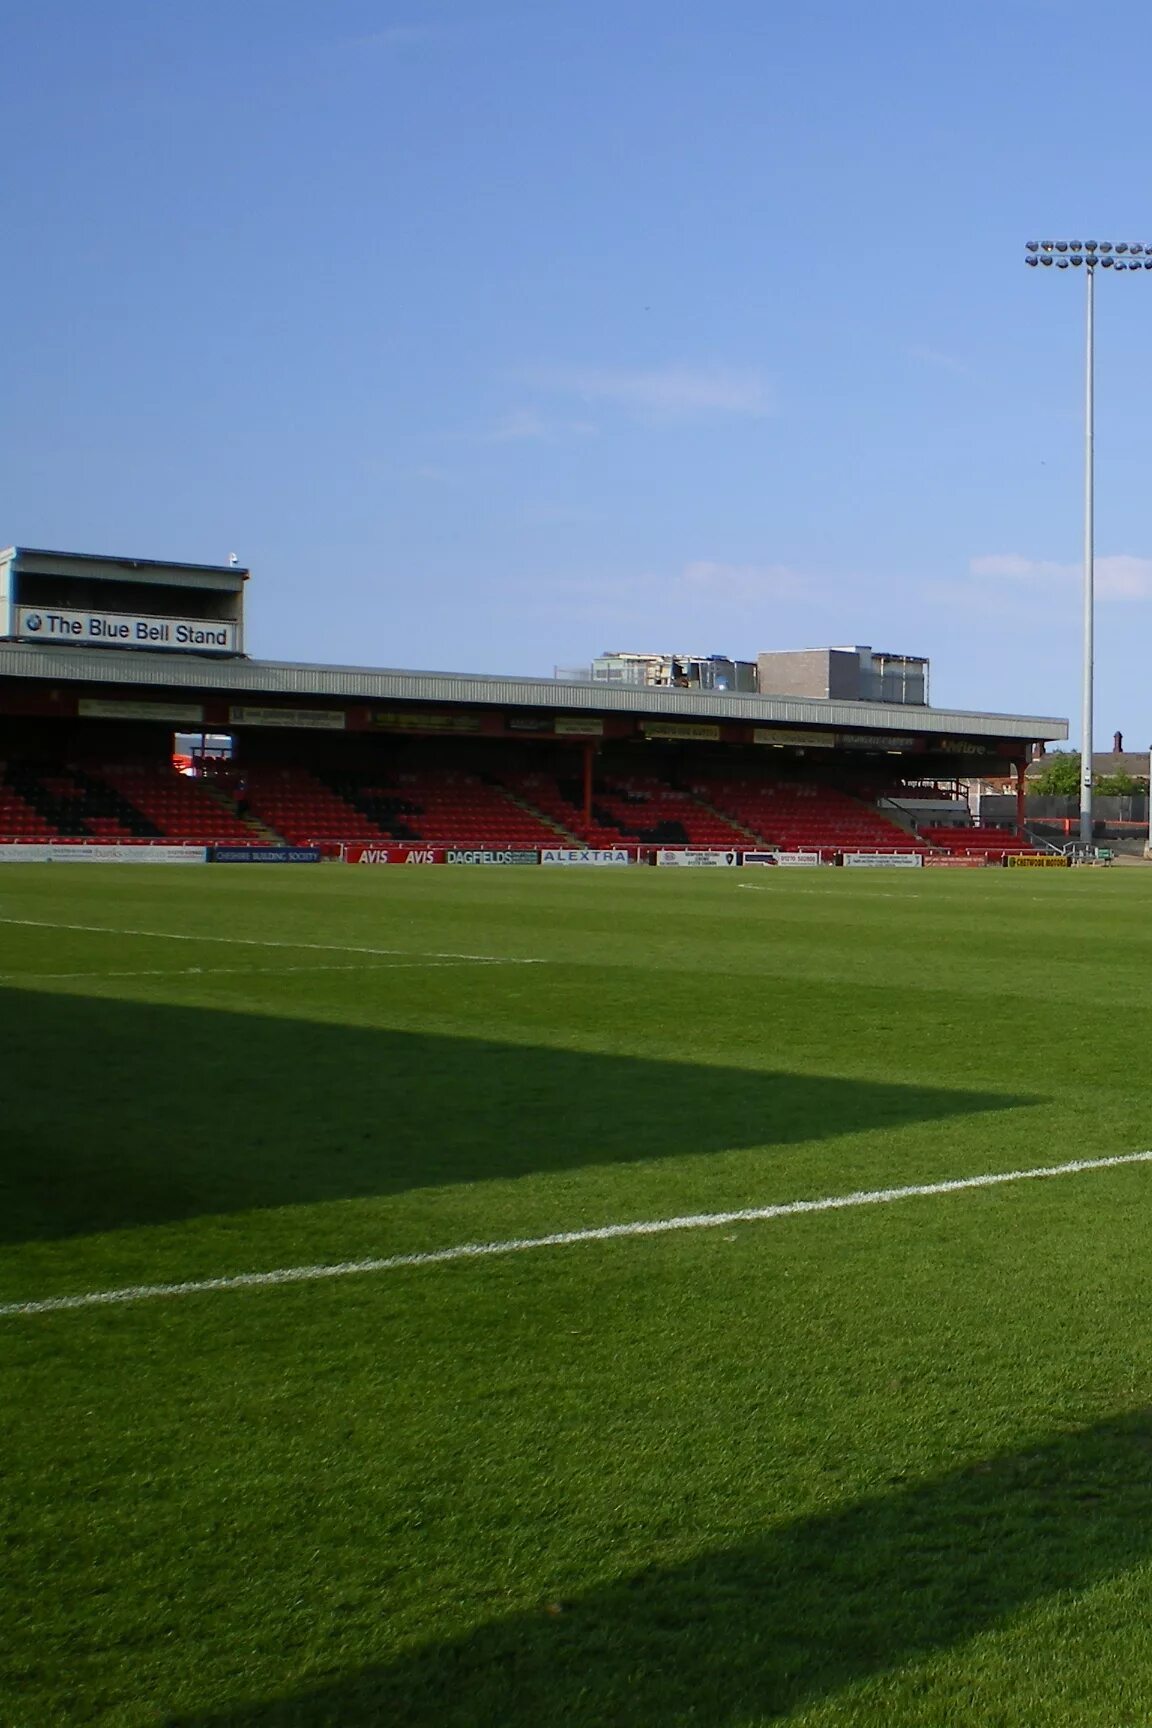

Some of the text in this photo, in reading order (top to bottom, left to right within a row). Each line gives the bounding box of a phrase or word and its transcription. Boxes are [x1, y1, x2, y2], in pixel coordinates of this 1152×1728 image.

[47, 615, 227, 645] The Blue Bell Stand
[358, 851, 388, 863] AVIS
[405, 851, 434, 863] AVIS
[447, 851, 513, 864] DAGFIELDS
[543, 851, 626, 861] ALEXTRA
